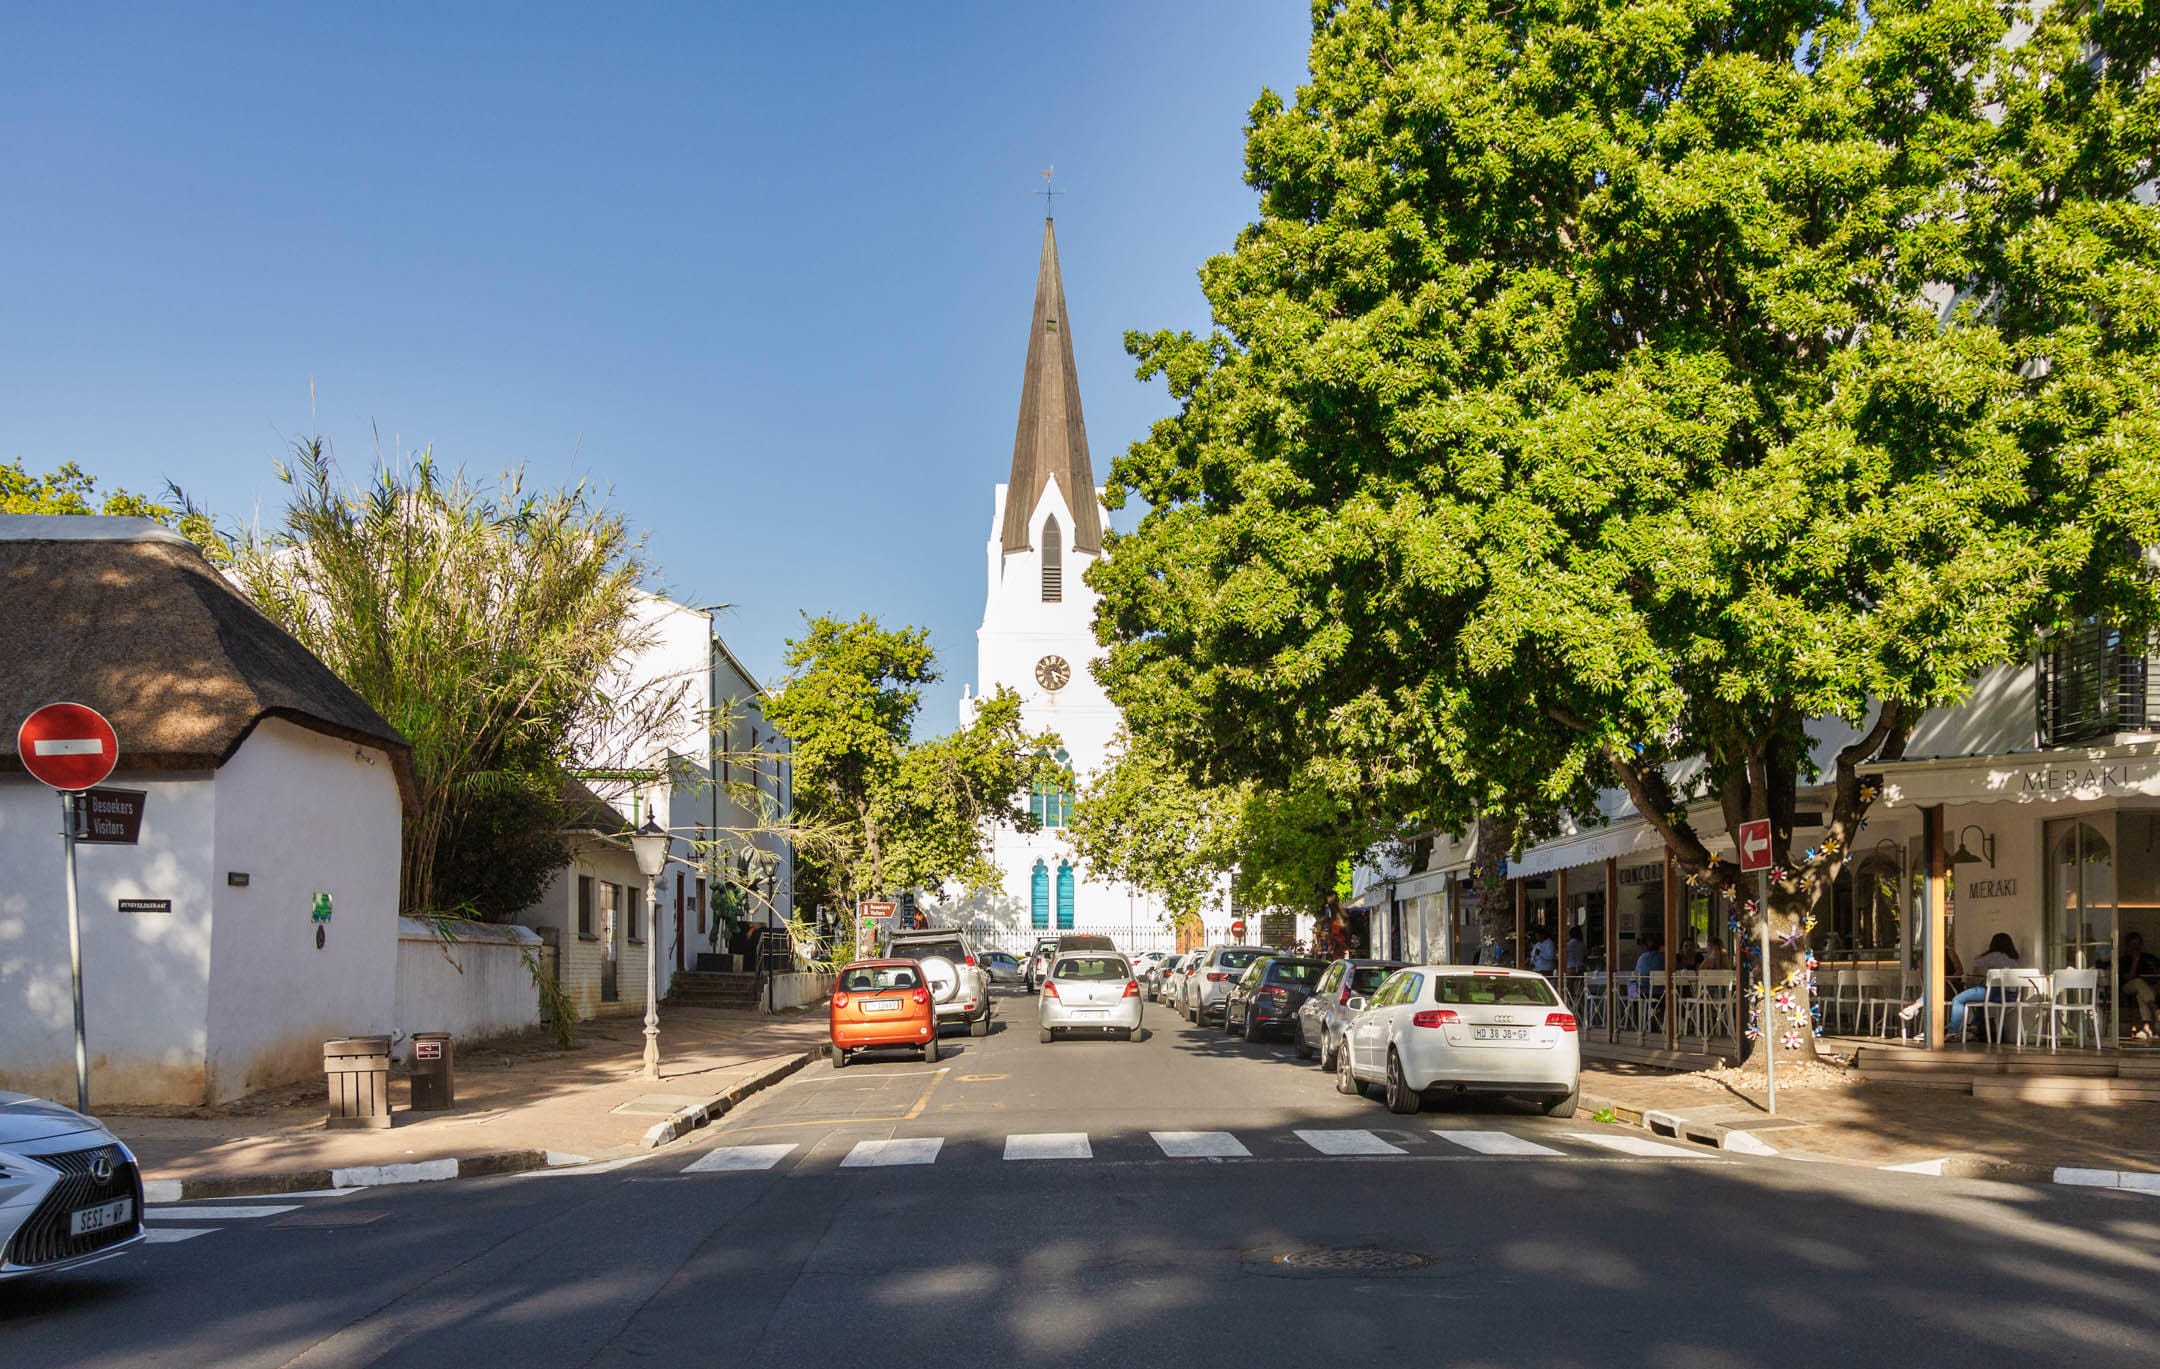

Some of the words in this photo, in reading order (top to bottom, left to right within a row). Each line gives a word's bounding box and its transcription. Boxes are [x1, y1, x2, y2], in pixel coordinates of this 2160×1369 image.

[2022, 766, 2128, 791] MERAKI
[92, 796, 134, 815] Besoekers
[93, 817, 125, 835] Visitors
[1968, 879, 2017, 899] MERAKI
